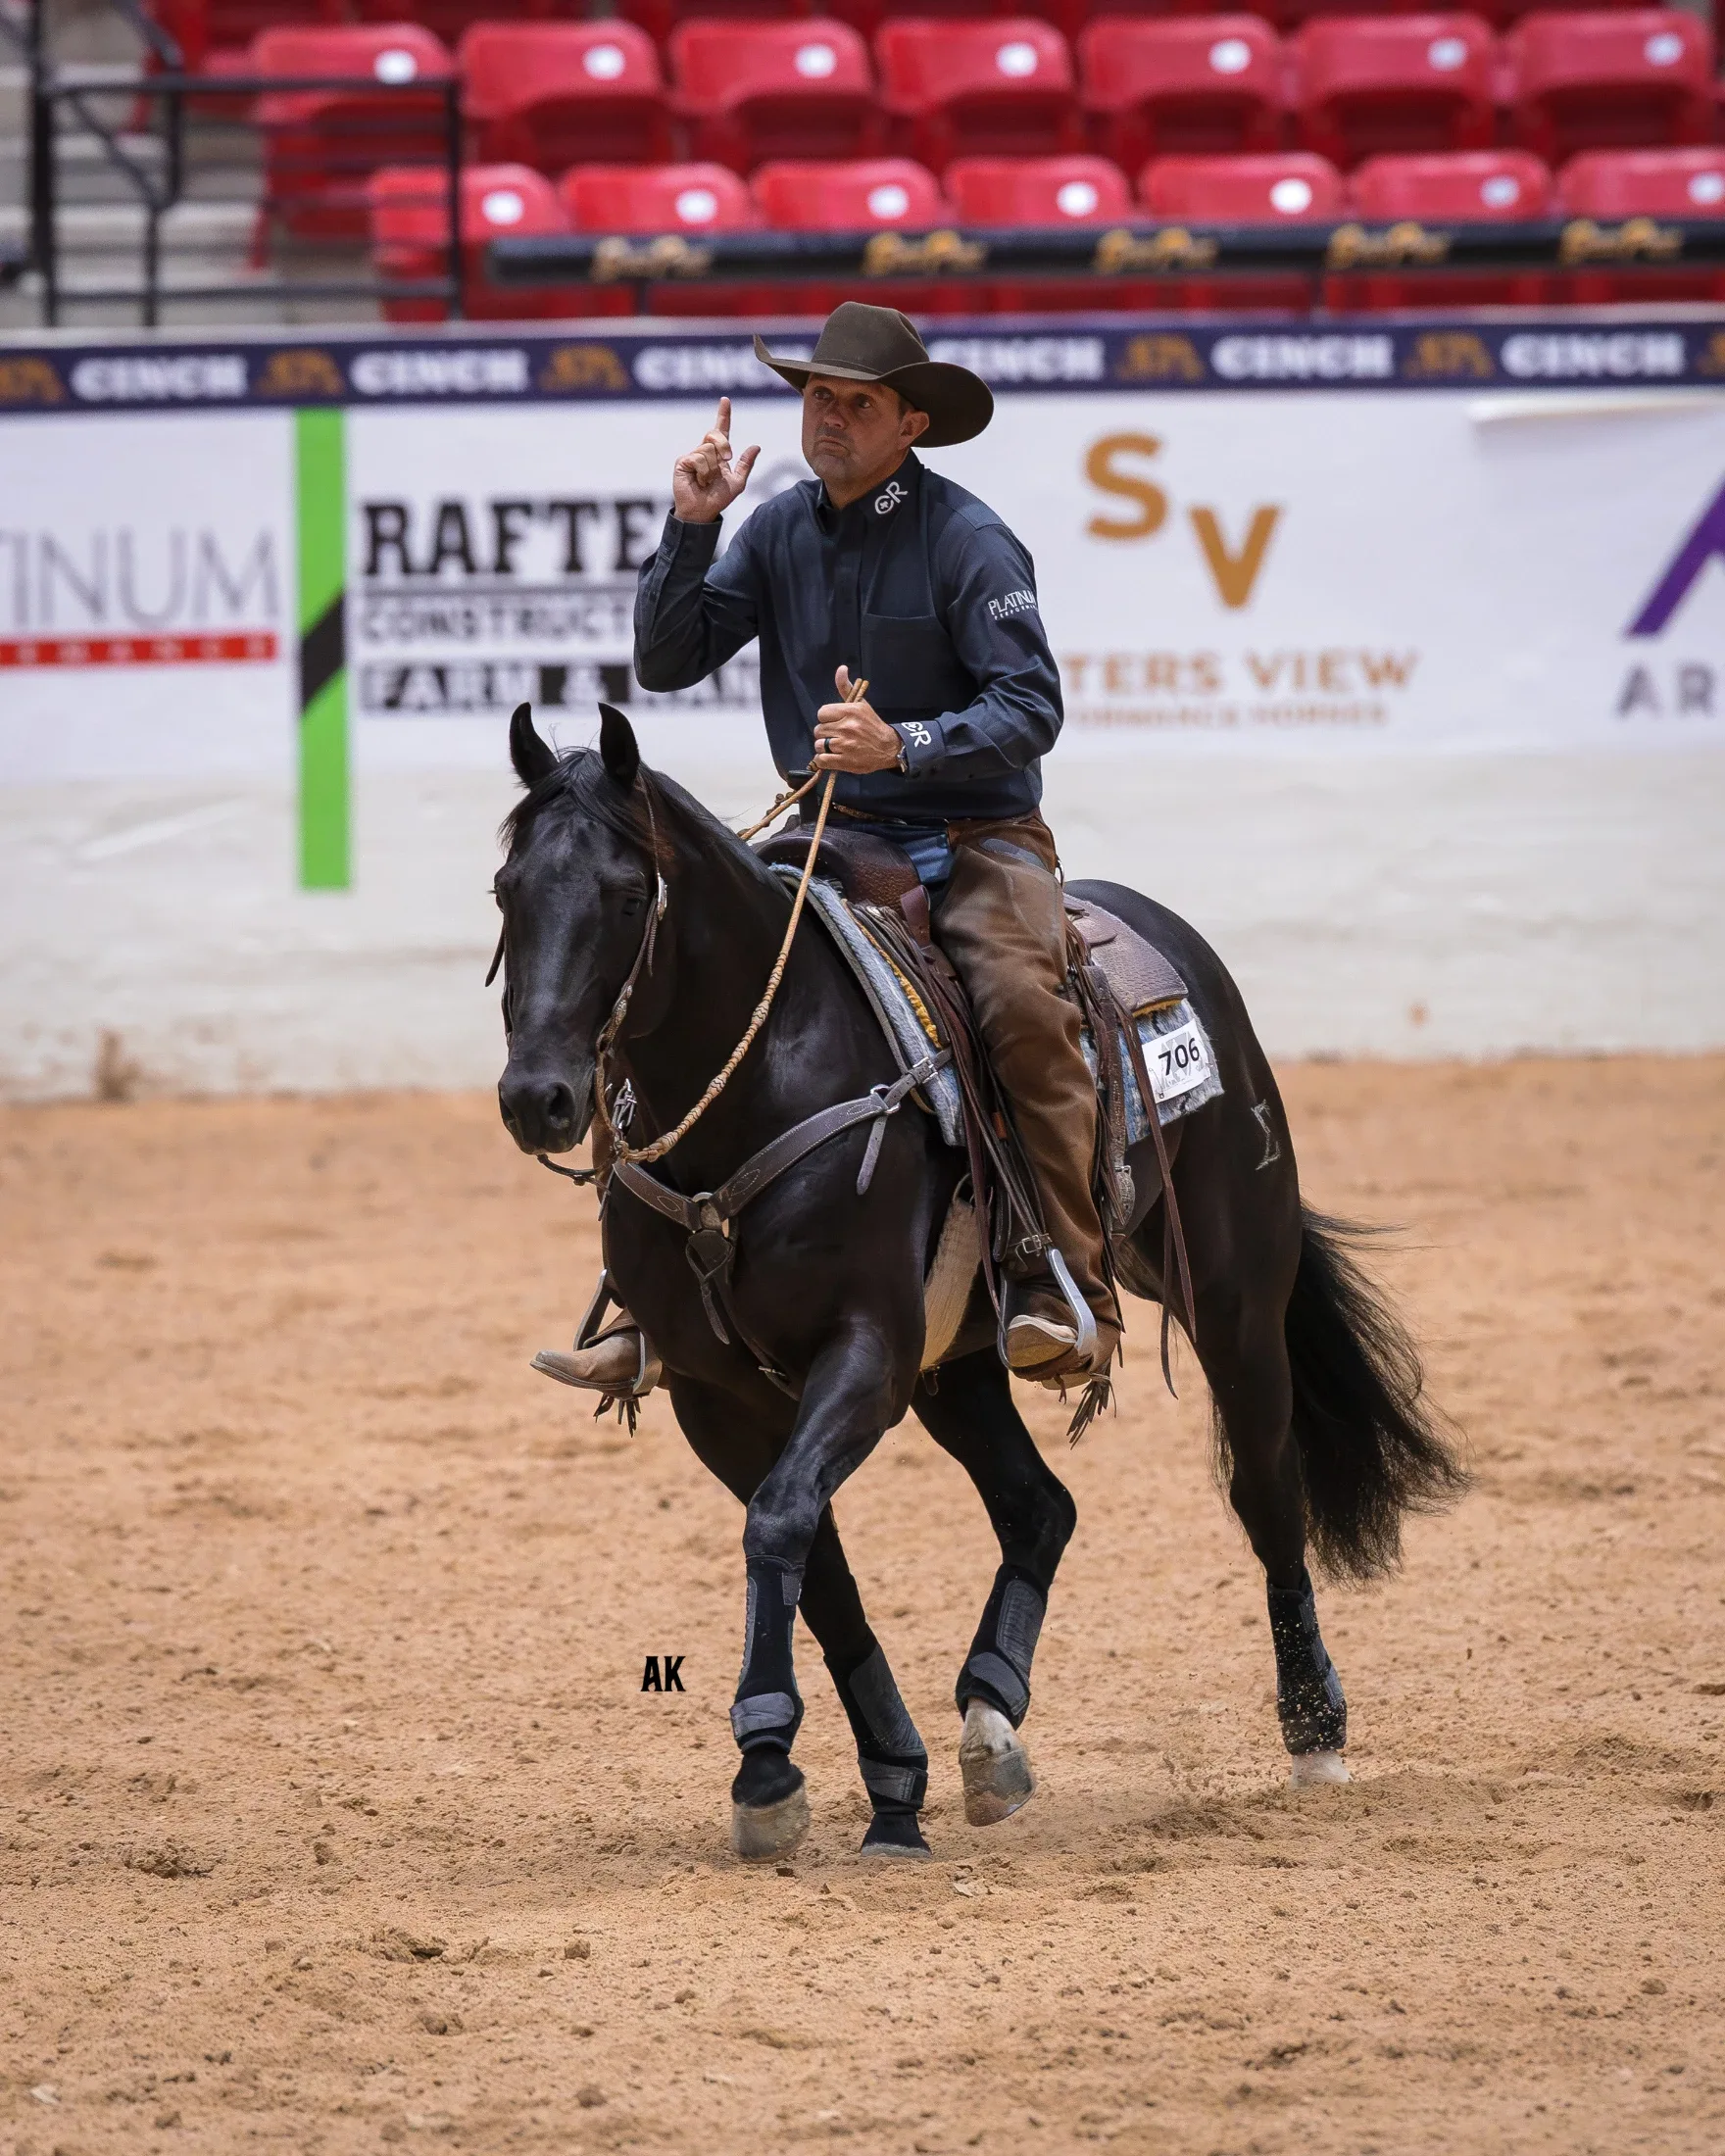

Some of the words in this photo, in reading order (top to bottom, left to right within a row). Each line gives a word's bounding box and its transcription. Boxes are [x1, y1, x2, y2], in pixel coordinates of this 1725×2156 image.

[349, 348, 529, 395] CINCH
[1211, 334, 1394, 379] CINCH
[1501, 332, 1685, 377] CINCH
[72, 355, 248, 401] CINCH
[363, 497, 674, 578] RAFTE
[988, 590, 1037, 615] PLATINU
[1245, 646, 1421, 692] VIEW
[1158, 1037, 1200, 1076] 706
